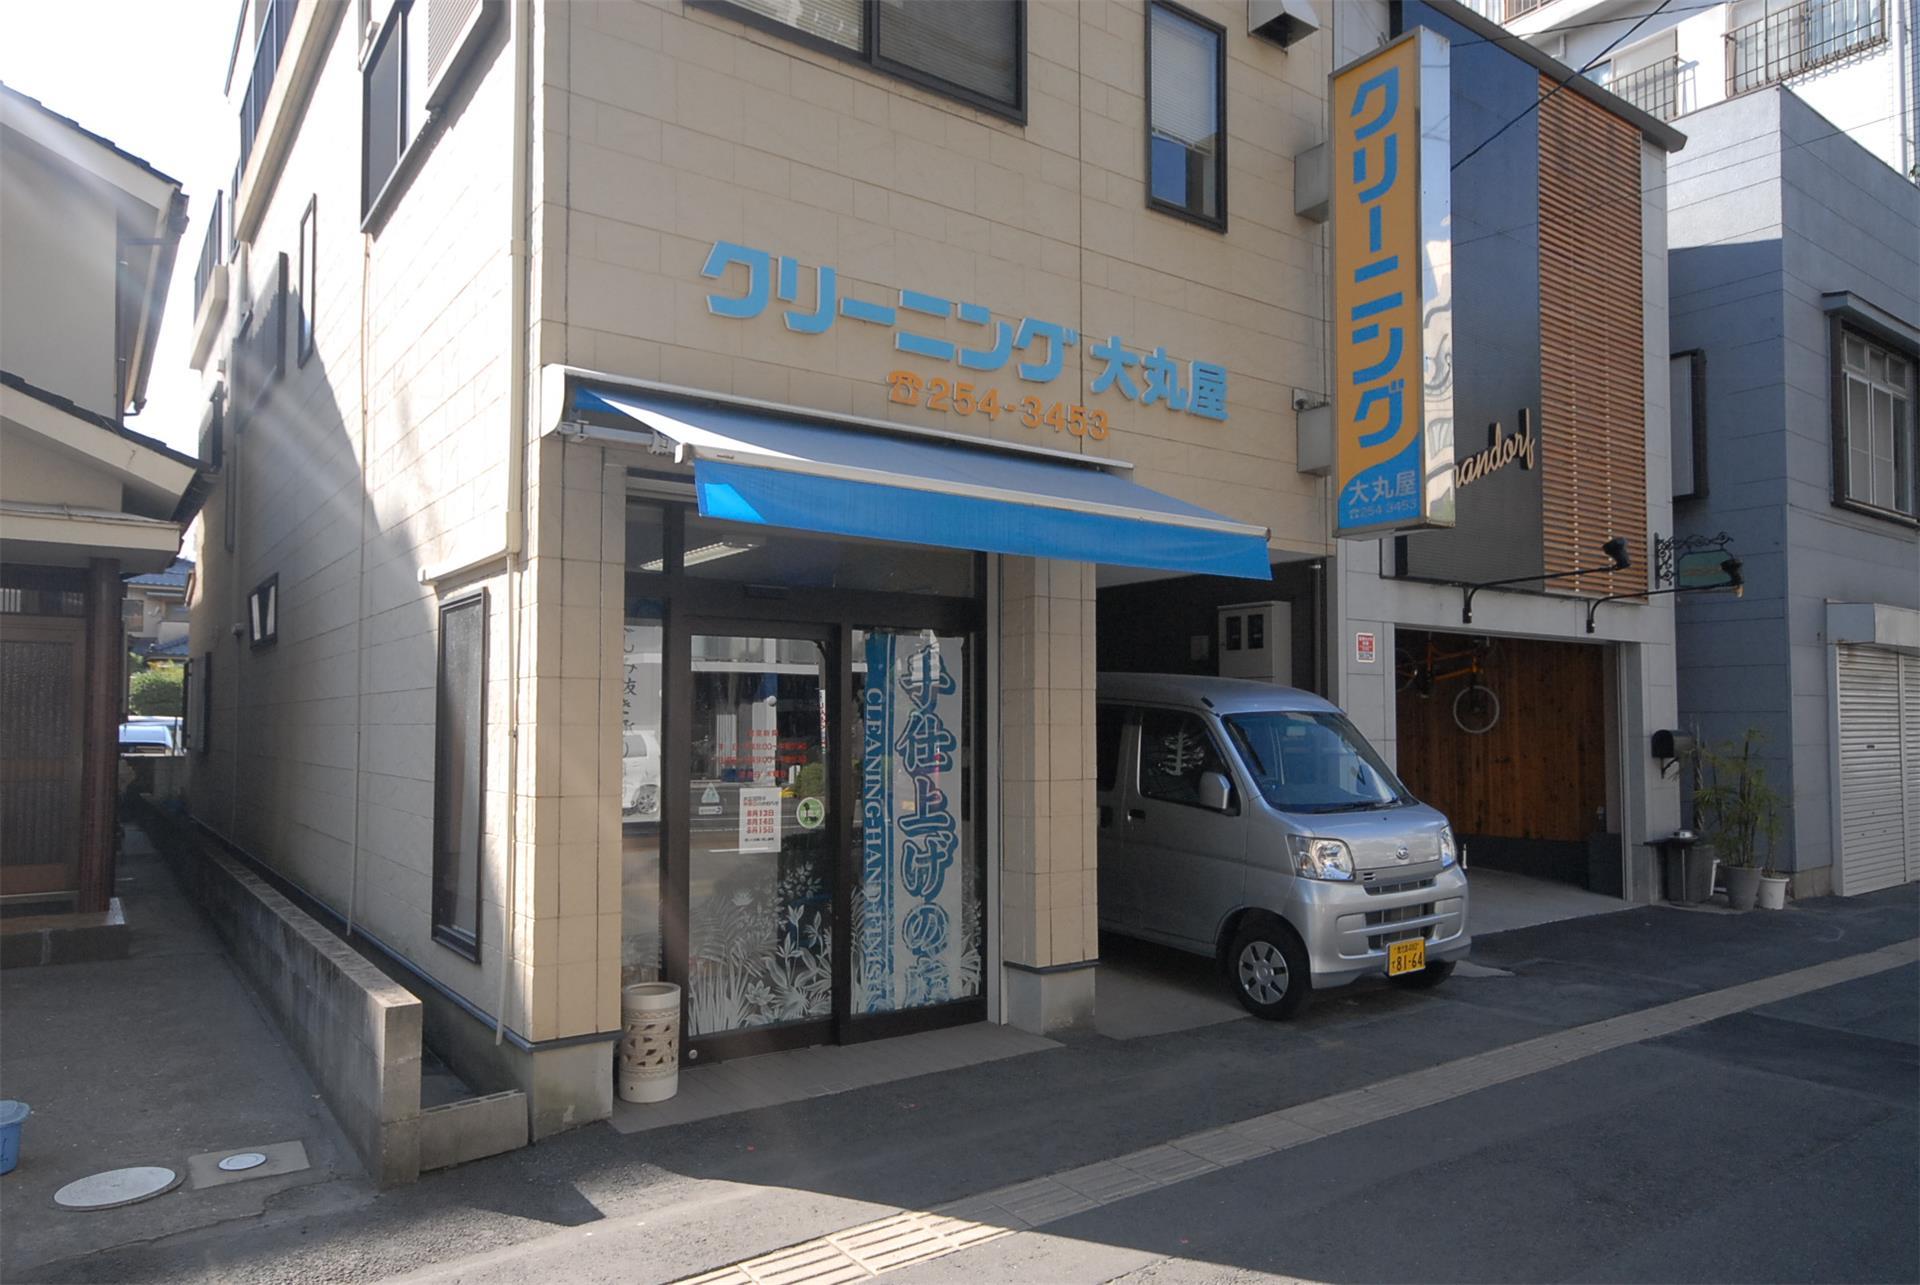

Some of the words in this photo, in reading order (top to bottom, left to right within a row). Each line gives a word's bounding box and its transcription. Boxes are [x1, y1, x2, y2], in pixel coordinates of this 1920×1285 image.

[701, 240, 1080, 383] クリーニング
[1089, 335, 1230, 422] 大丸屋
[1351, 65, 1405, 449] クリーニング
[1348, 469, 1416, 505] 大丸屋
